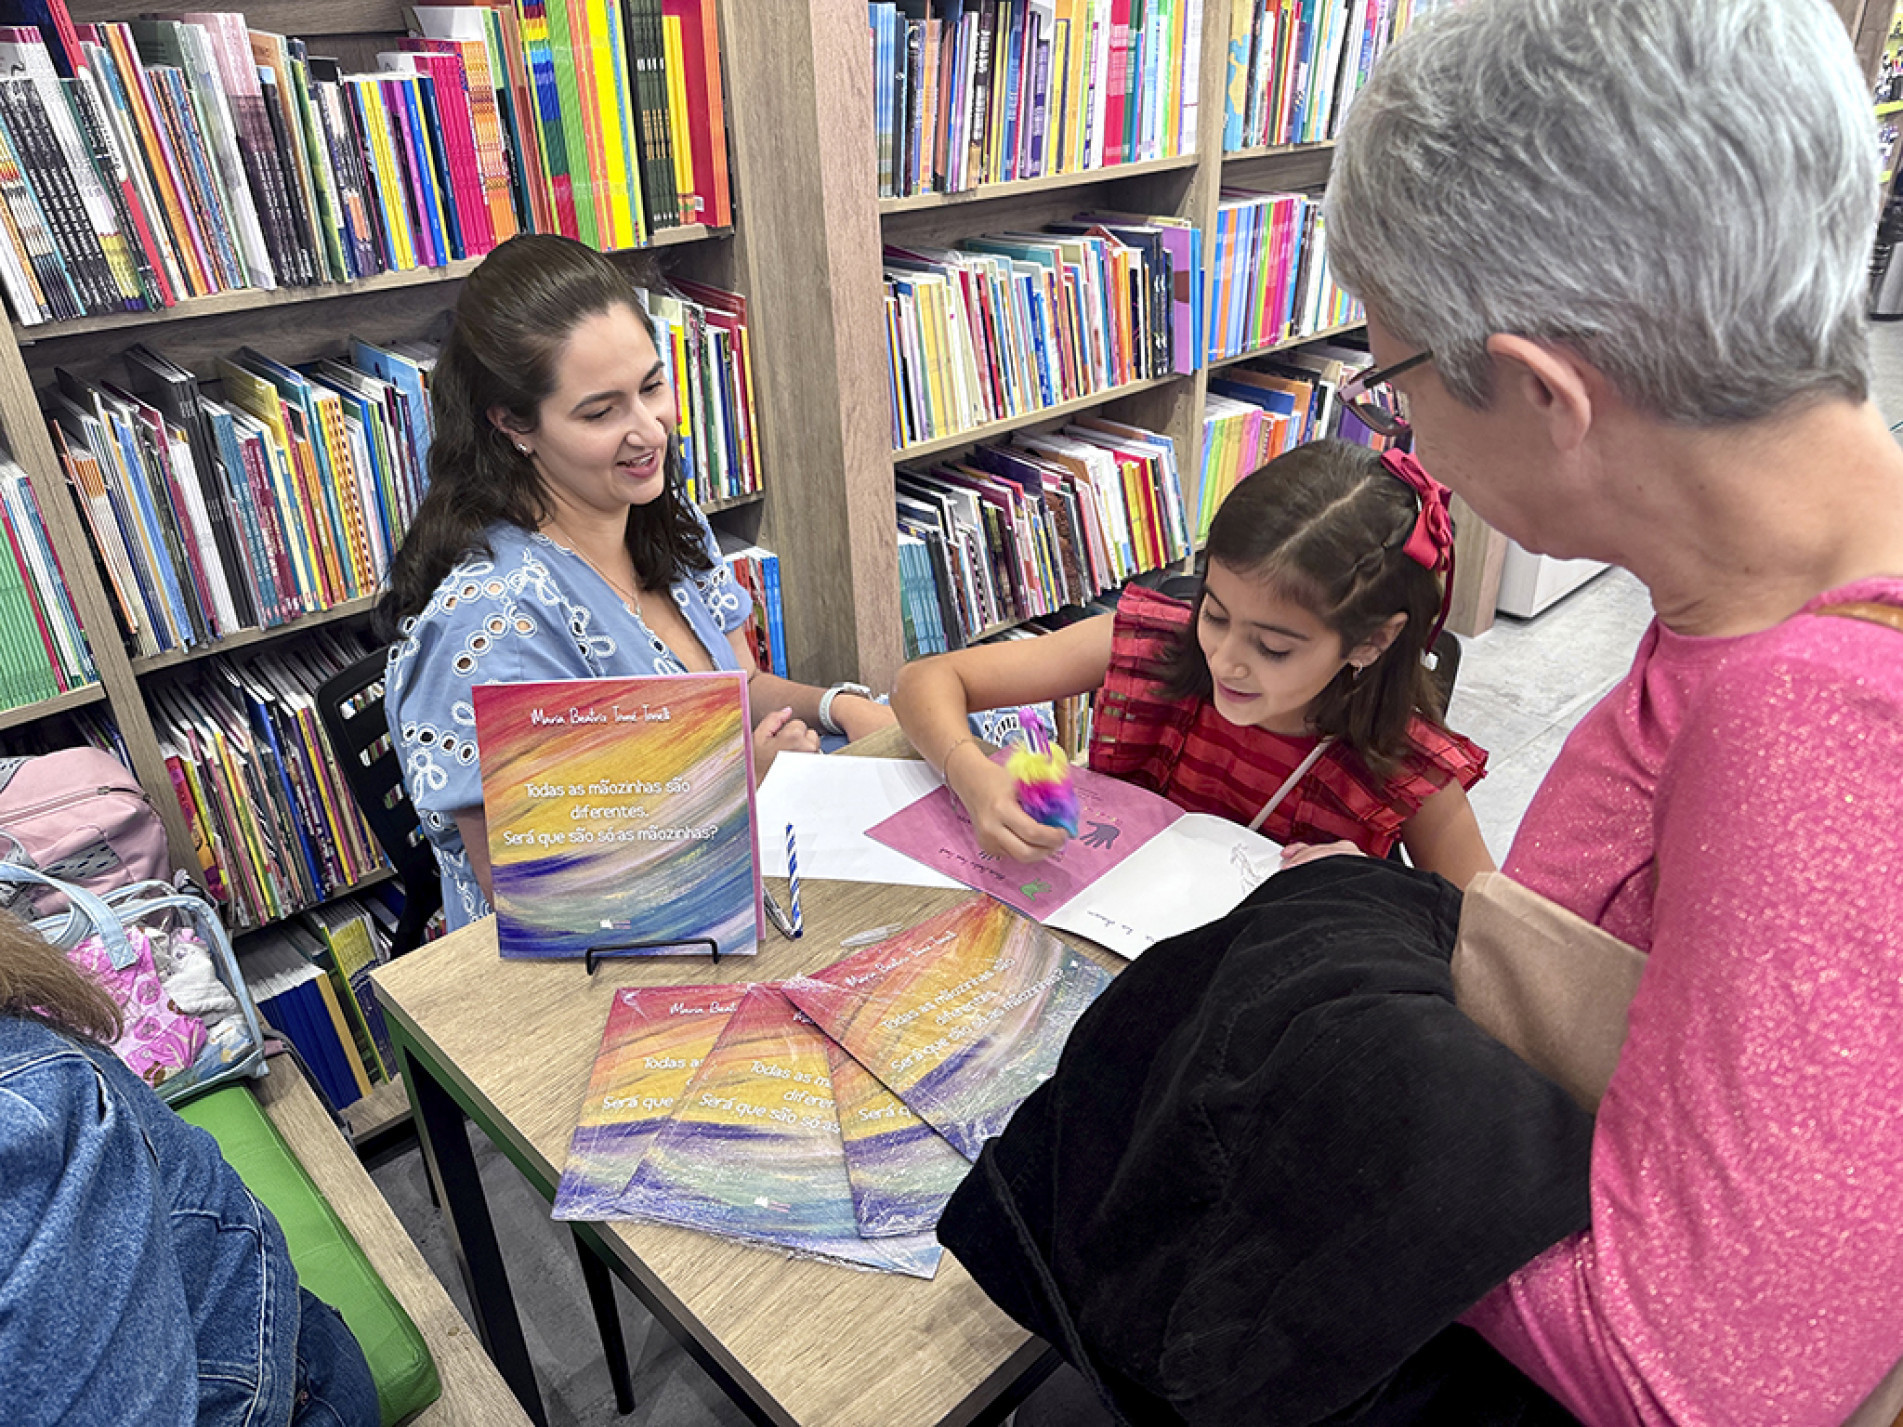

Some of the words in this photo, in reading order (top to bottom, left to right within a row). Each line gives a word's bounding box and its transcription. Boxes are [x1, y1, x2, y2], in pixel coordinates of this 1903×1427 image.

[531, 708, 565, 726] Maria
[570, 707, 607, 725] Beatriz
[524, 783, 565, 798] Todas
[569, 784, 585, 796] as
[588, 779, 662, 796] mãozinhas
[666, 776, 690, 793] são
[570, 804, 650, 820] diferentes.
[503, 829, 534, 846] Será
[538, 832, 565, 848] que
[569, 827, 593, 843] são
[598, 826, 615, 842] só
[618, 830, 634, 842] as
[637, 825, 718, 841] mãozinhas?
[881, 1008, 920, 1029] Todas
[918, 1001, 936, 1013] as
[934, 970, 995, 1005] mãozinhas
[993, 958, 1015, 972] são
[669, 1002, 704, 1015] Maria
[709, 1001, 737, 1014] Beat
[891, 1049, 924, 1072] Será
[923, 1038, 950, 1056] que
[949, 1026, 973, 1041] são
[643, 1057, 686, 1069] Todas
[751, 1060, 791, 1079] Todas
[794, 1071, 813, 1084] as
[813, 1075, 831, 1089] m
[603, 1095, 641, 1110] Será
[642, 1097, 674, 1111] que
[699, 1093, 735, 1112] Será
[736, 1102, 767, 1119] que
[769, 1107, 798, 1124] são
[801, 1115, 822, 1129] só
[823, 1121, 841, 1134] as
[858, 1101, 895, 1121] Será
[899, 1105, 912, 1120] q
